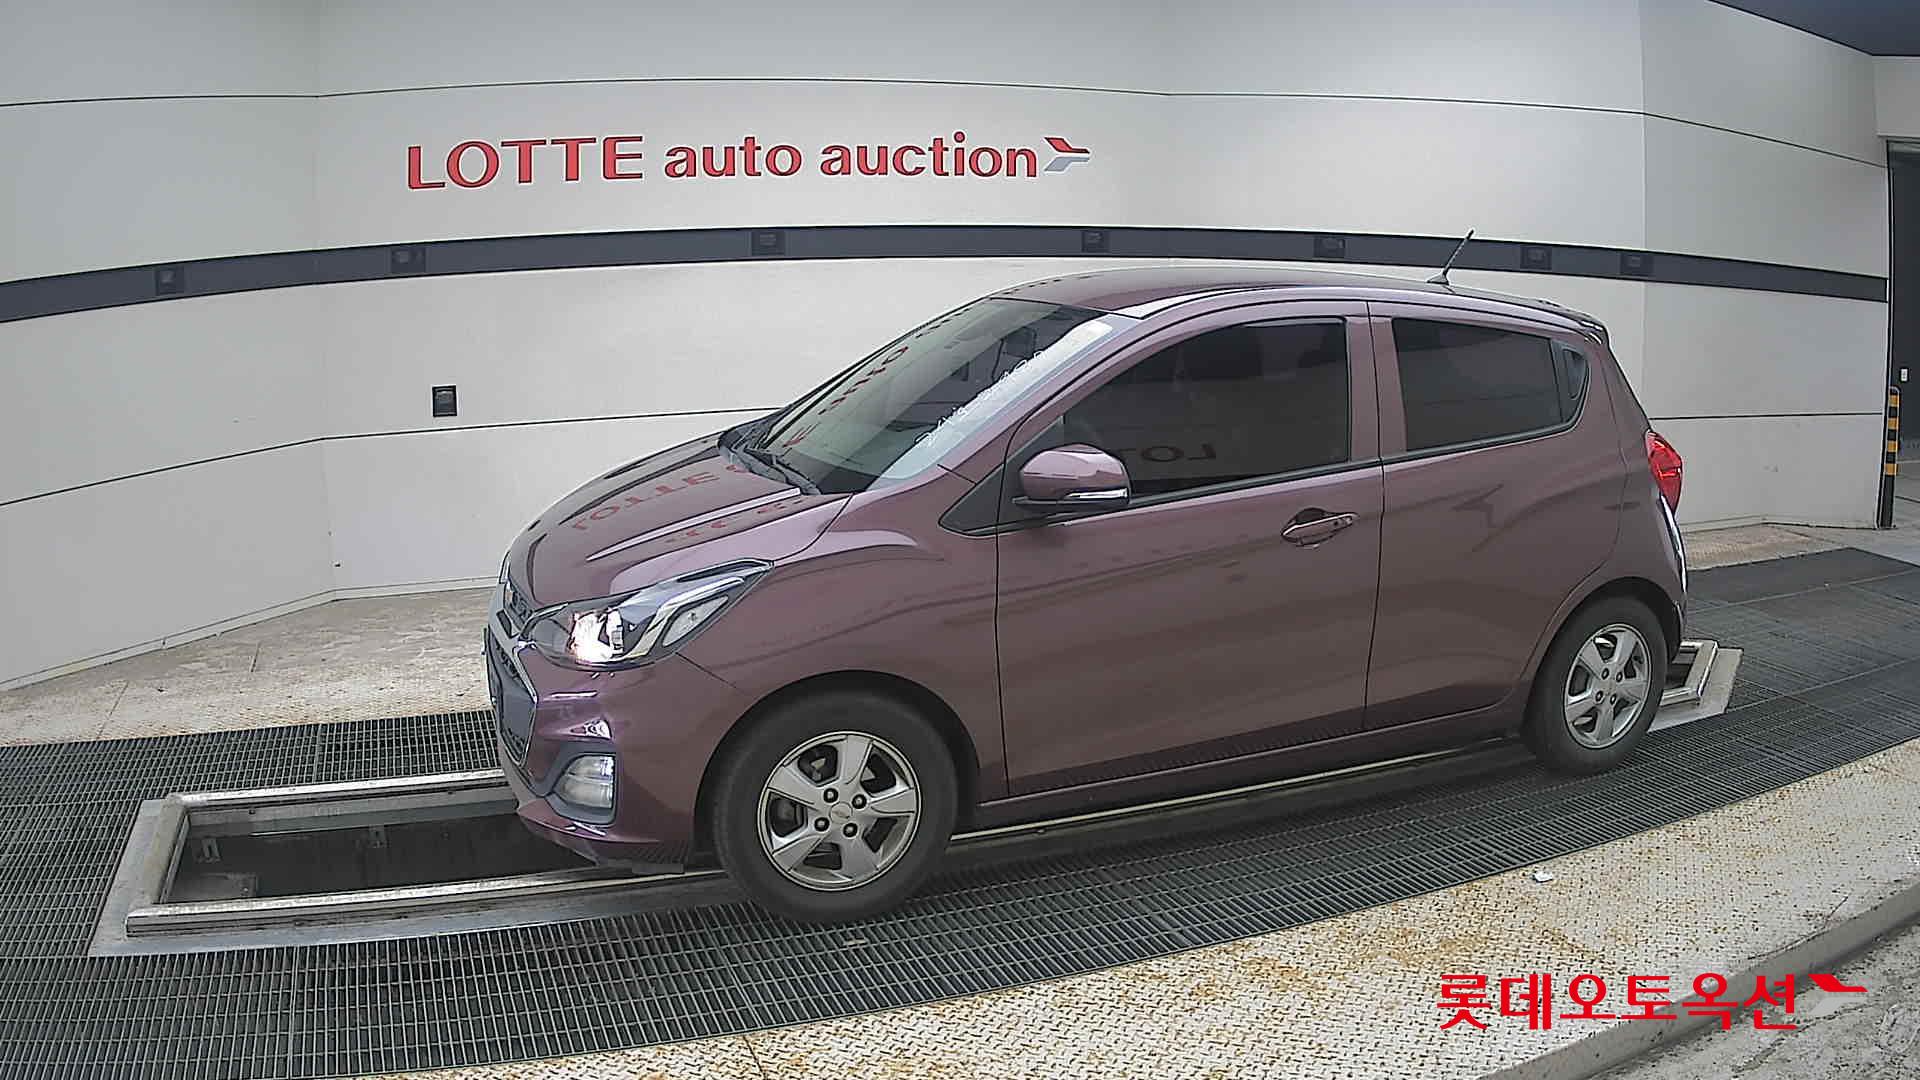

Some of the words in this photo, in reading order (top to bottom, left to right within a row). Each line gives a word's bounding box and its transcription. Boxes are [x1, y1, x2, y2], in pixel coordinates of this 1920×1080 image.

[407, 136, 645, 190] LOTTE
[664, 136, 802, 178] auto
[820, 131, 1038, 178] auction
